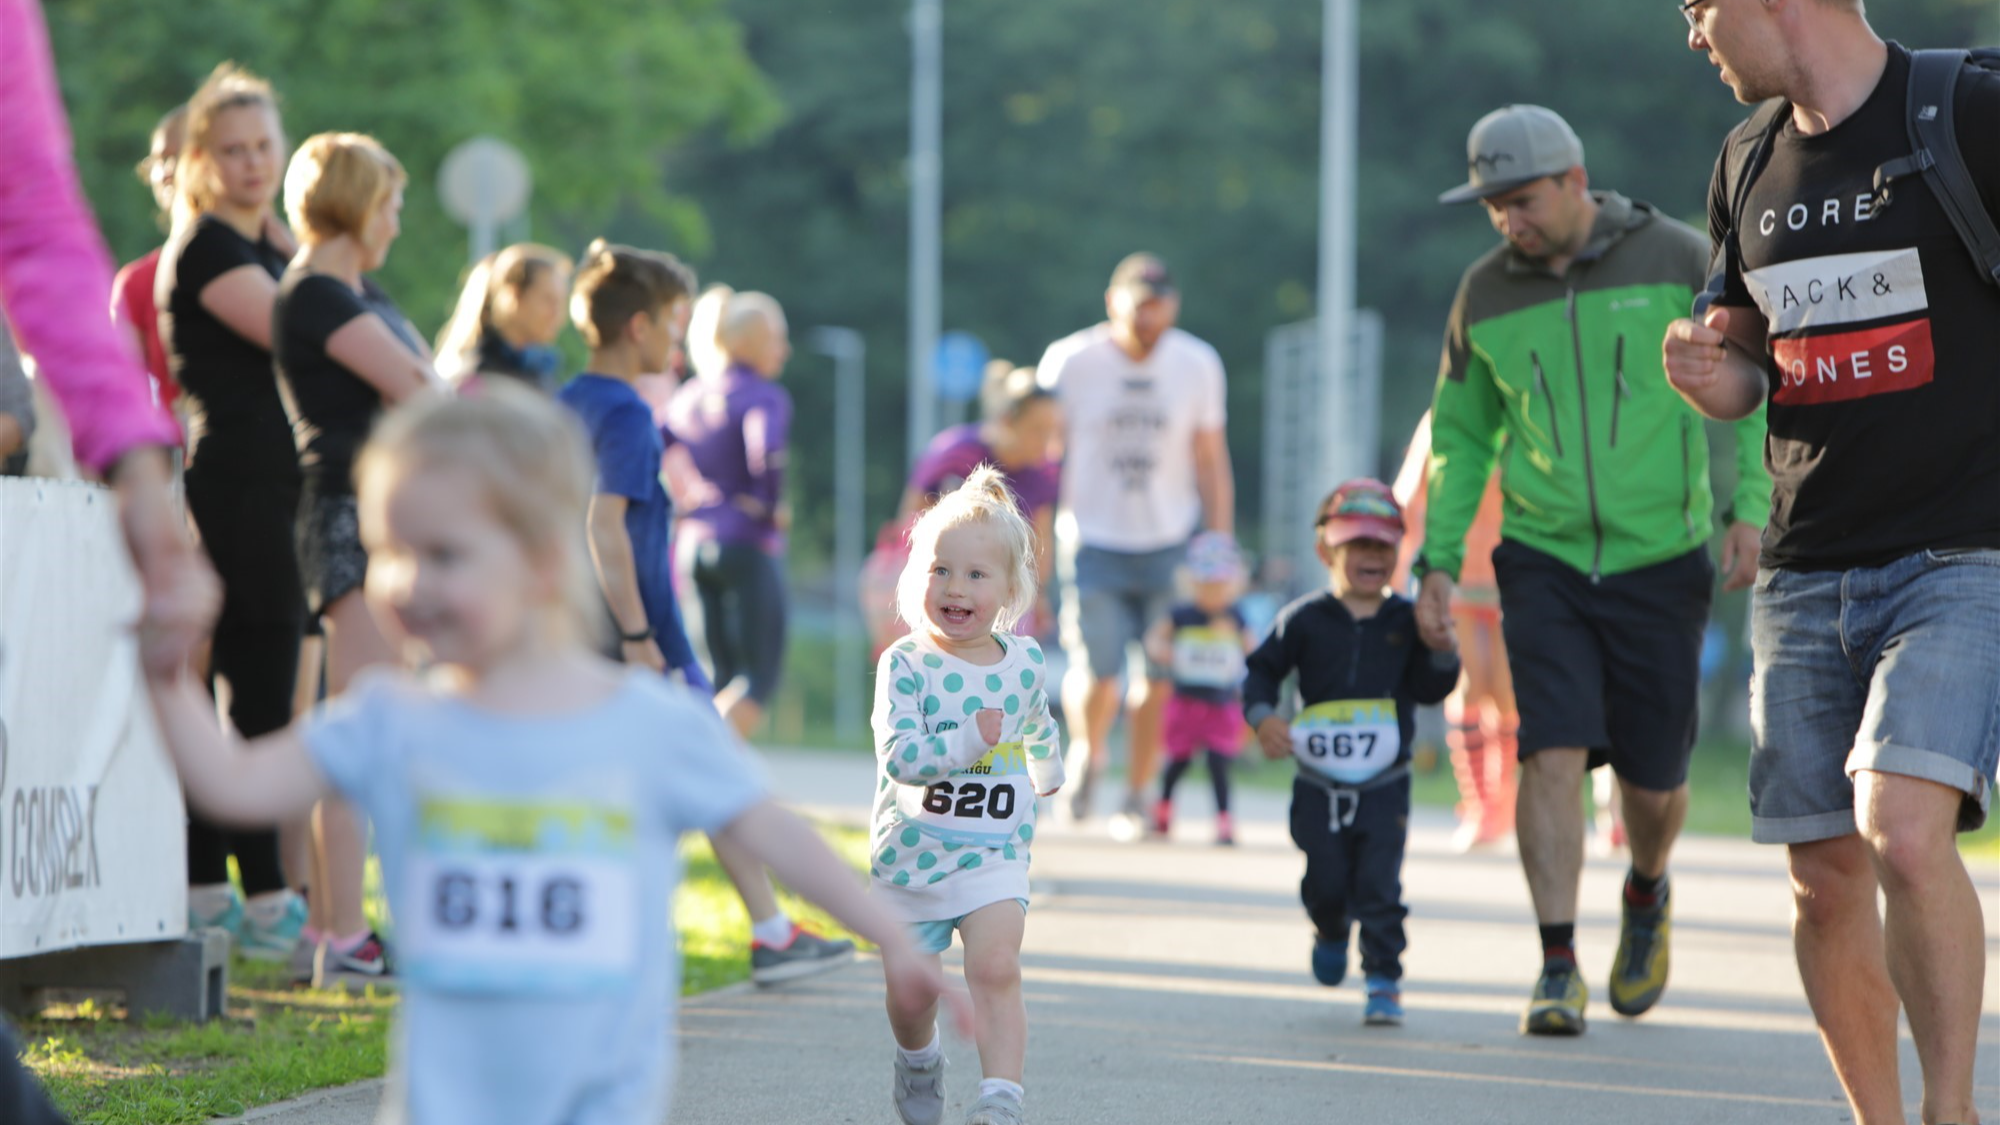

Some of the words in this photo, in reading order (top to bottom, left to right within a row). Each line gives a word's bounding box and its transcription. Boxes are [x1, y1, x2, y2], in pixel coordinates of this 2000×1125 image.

[1759, 193, 1872, 236] CORE
[1764, 276, 1857, 310] ACK
[1872, 272, 1893, 296] &
[1782, 345, 1908, 387] JONES
[1308, 734, 1377, 759] 667
[922, 781, 1015, 820] 620
[434, 871, 586, 937] 616
